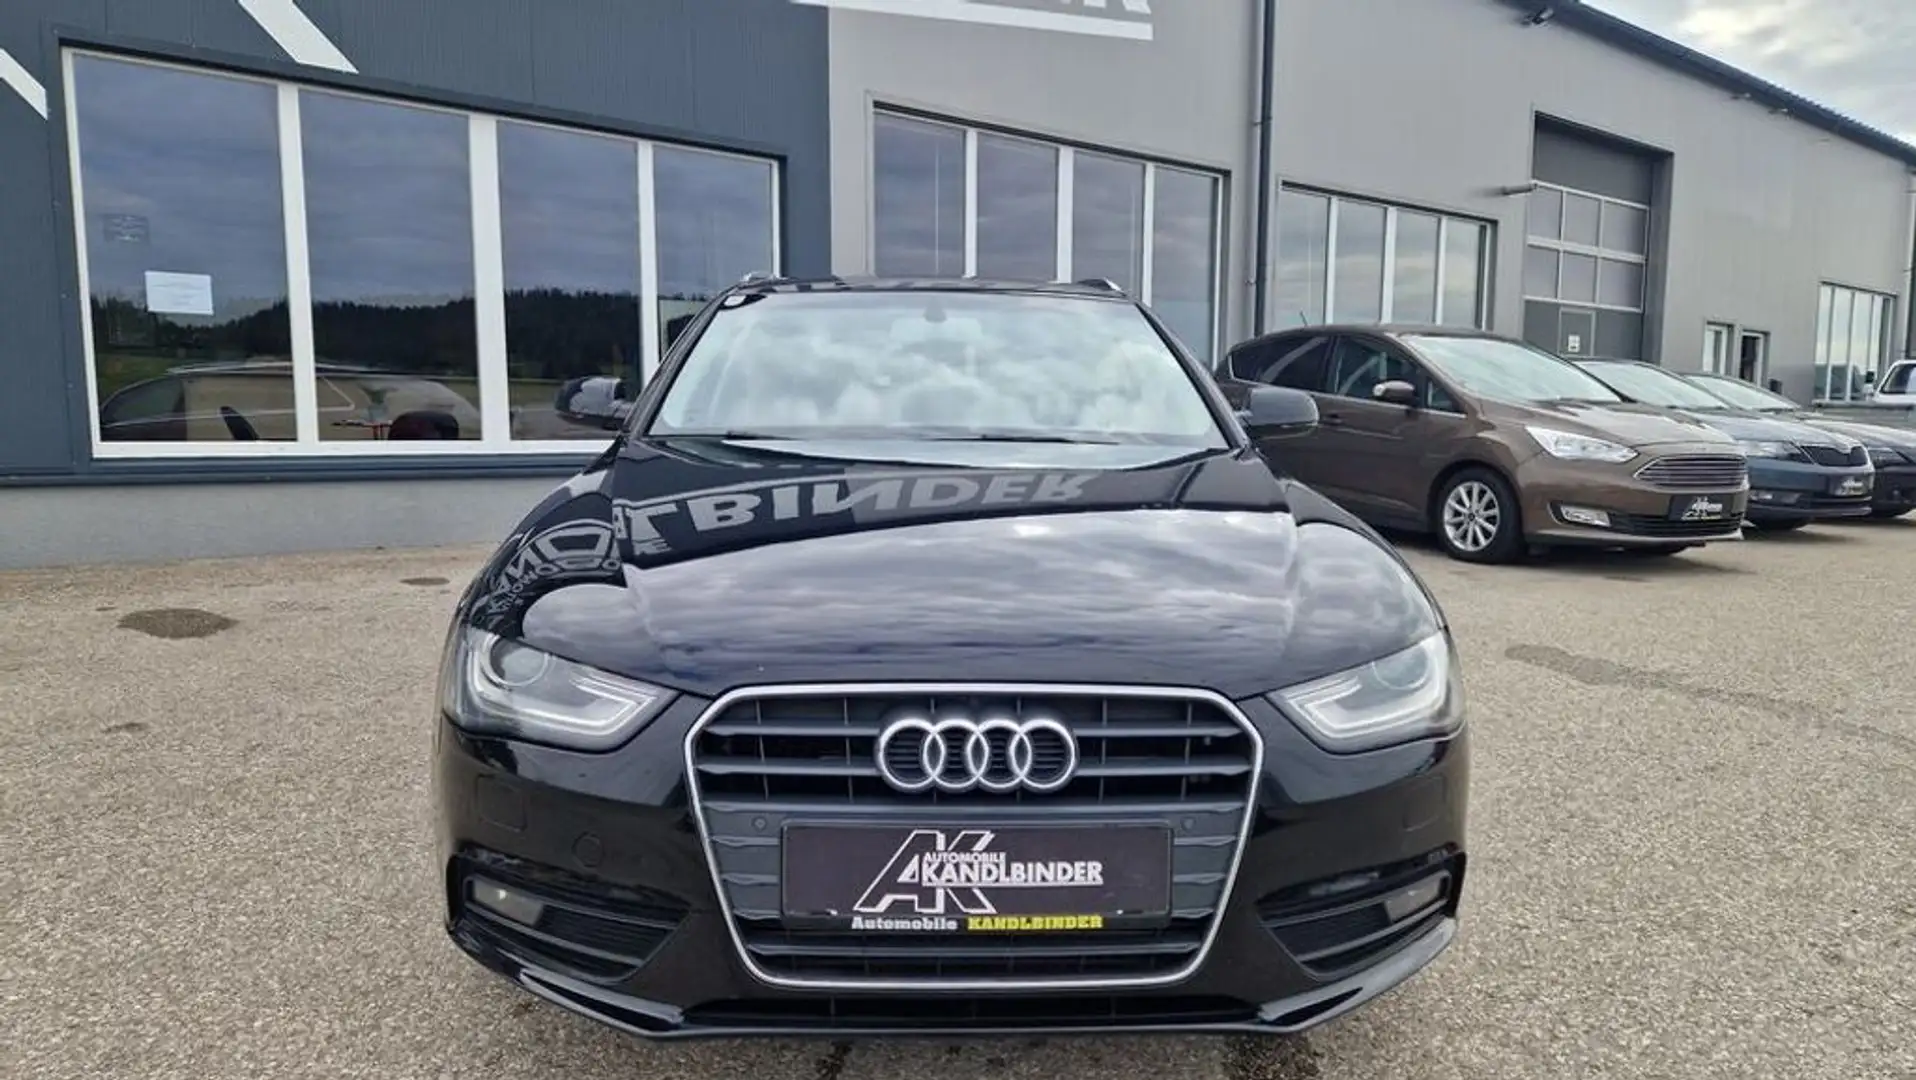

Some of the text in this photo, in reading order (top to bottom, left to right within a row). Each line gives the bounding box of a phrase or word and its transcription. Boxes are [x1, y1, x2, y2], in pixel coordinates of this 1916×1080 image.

[924, 852, 1005, 863] AUTOMOBILE
[921, 853, 1104, 885] KANDLBINDER
[851, 915, 1103, 931] Automobile KANDLBINDER
